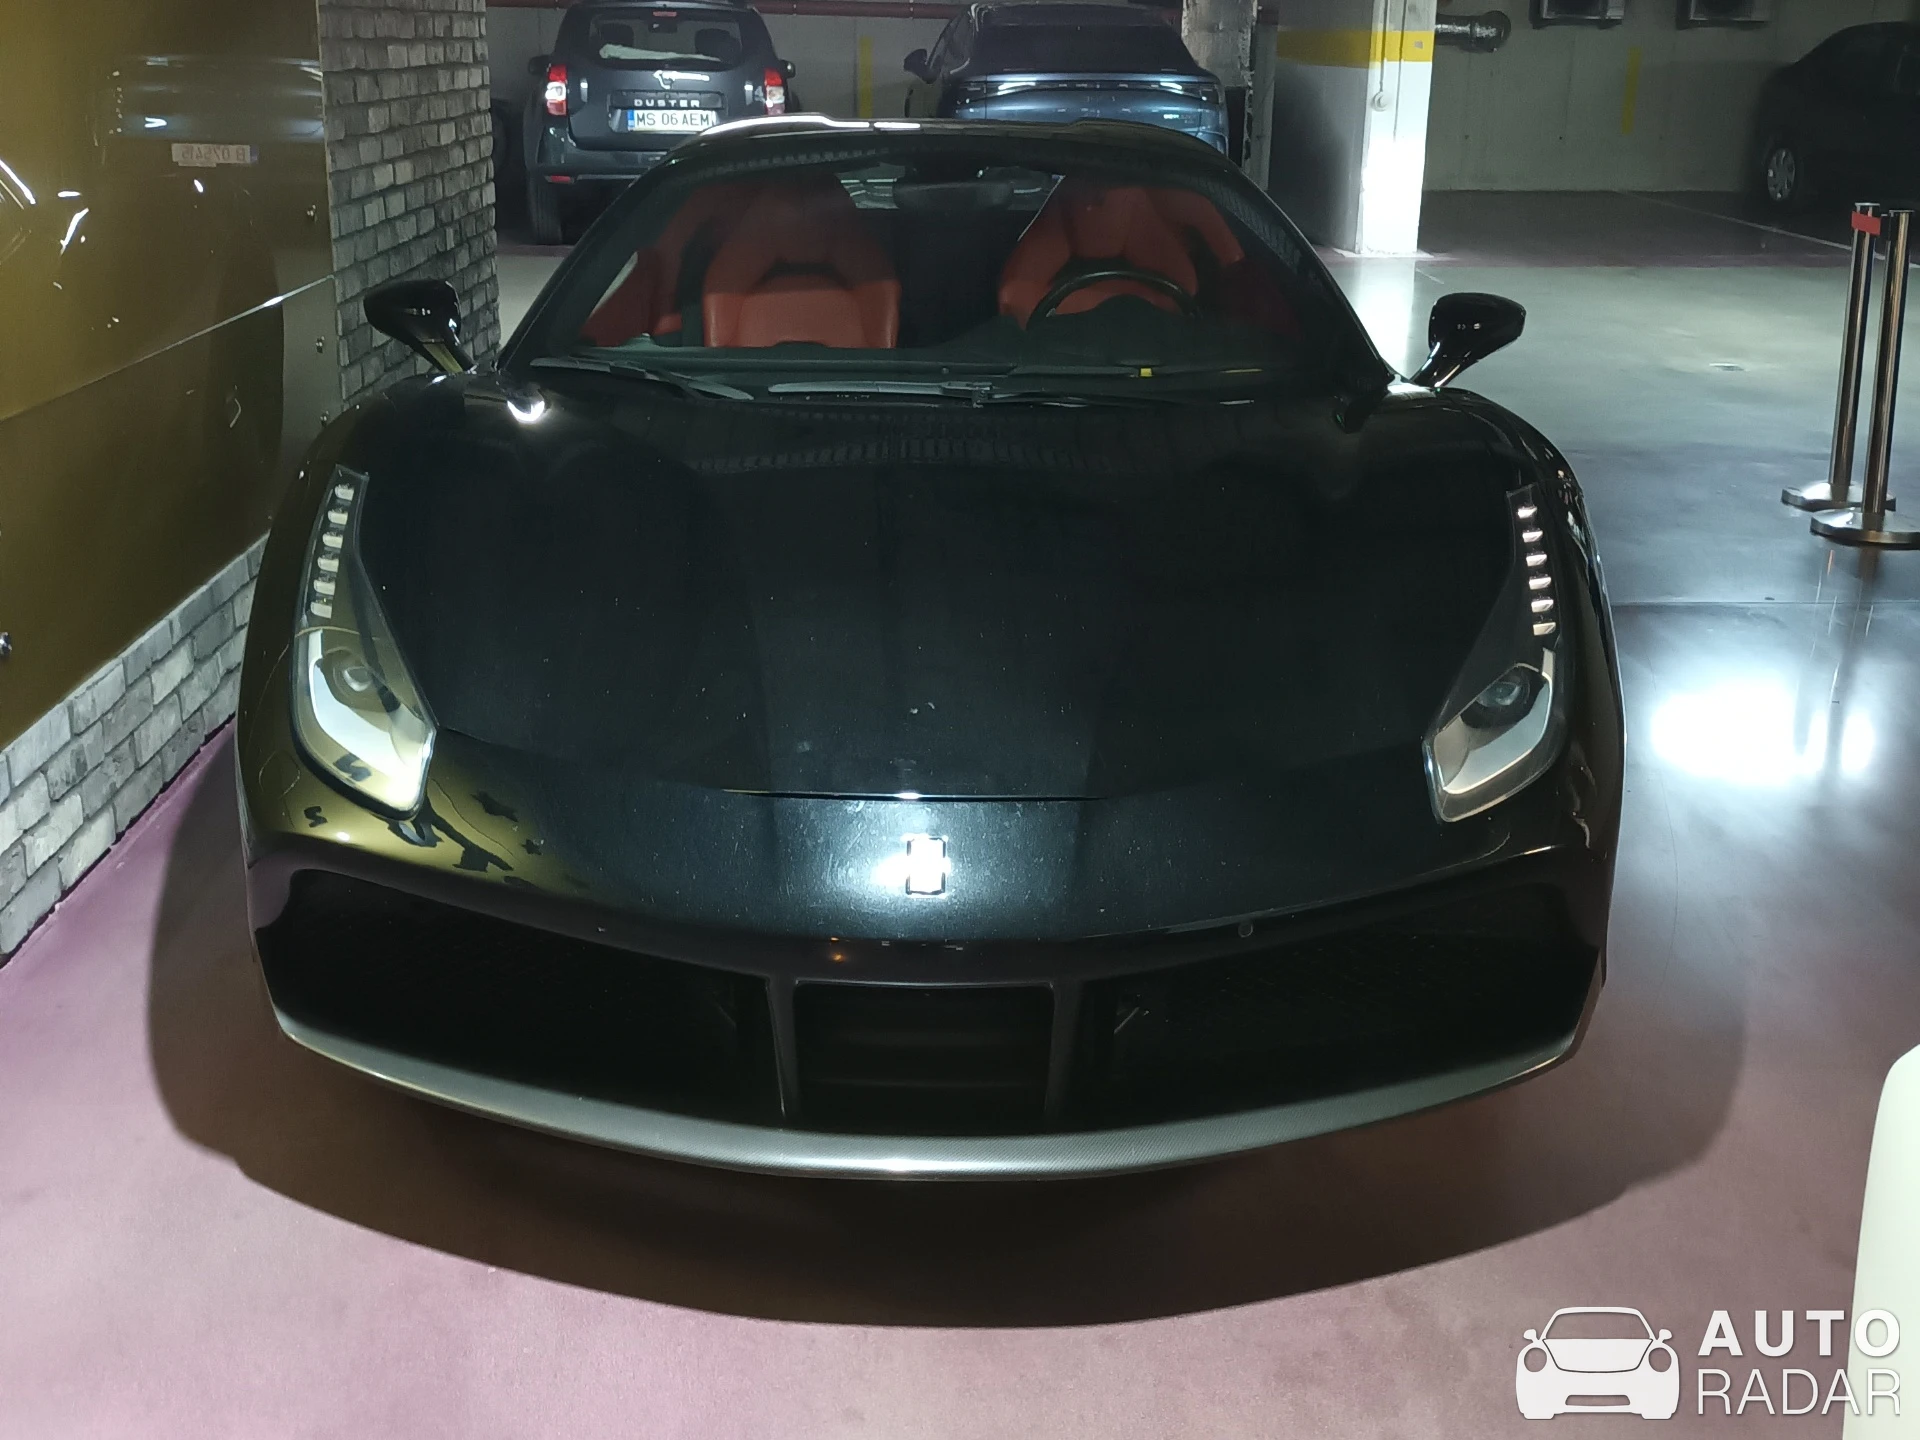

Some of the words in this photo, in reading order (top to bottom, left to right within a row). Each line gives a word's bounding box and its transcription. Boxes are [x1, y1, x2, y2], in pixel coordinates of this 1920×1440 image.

[634, 98, 700, 108] DUSTER
[637, 113, 656, 126] MS
[661, 113, 678, 126] 06
[682, 113, 709, 126] AEM
